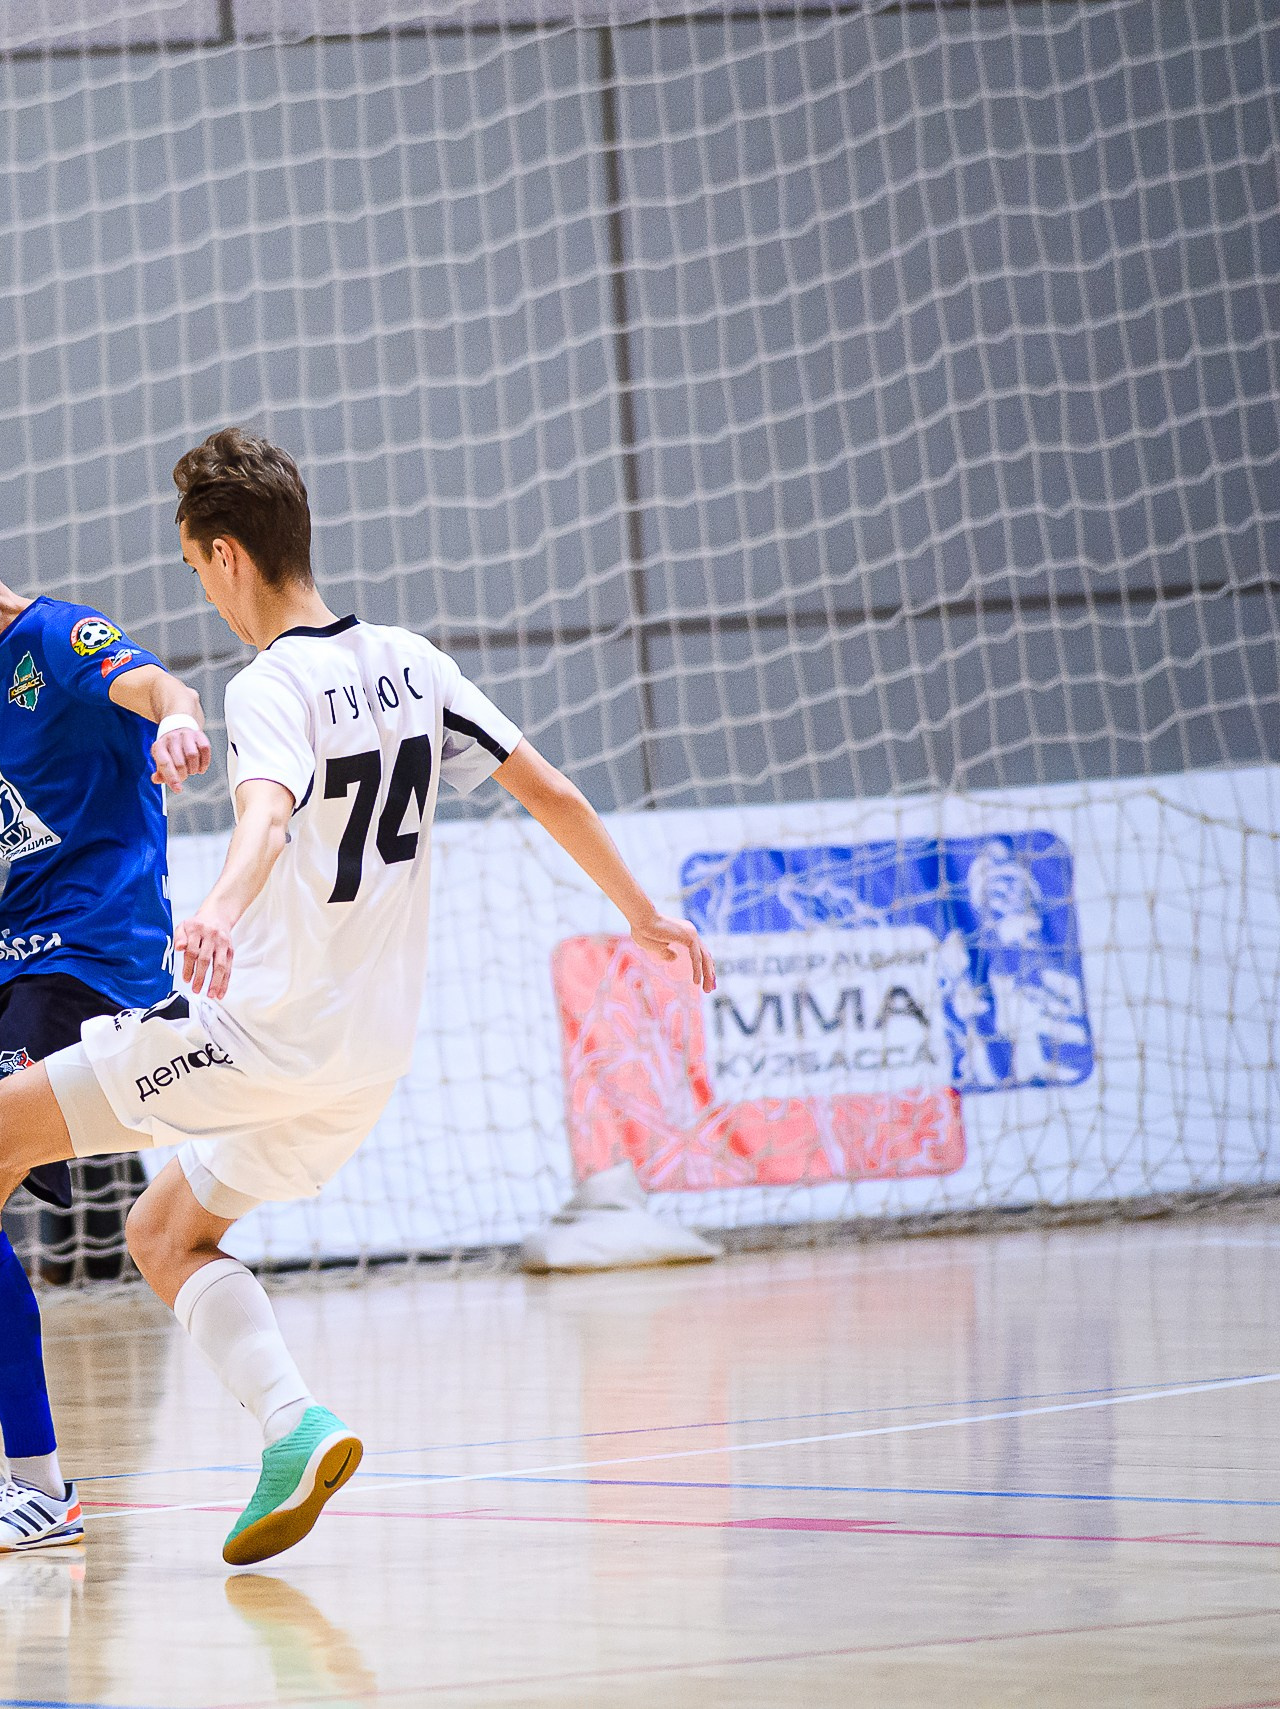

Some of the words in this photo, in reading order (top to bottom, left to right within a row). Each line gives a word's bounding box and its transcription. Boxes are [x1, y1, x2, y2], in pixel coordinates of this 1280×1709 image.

[324, 667, 424, 725] ТУЮС
[712, 985, 932, 1038] ММА
[715, 1046, 937, 1077] КУЗБАССА
